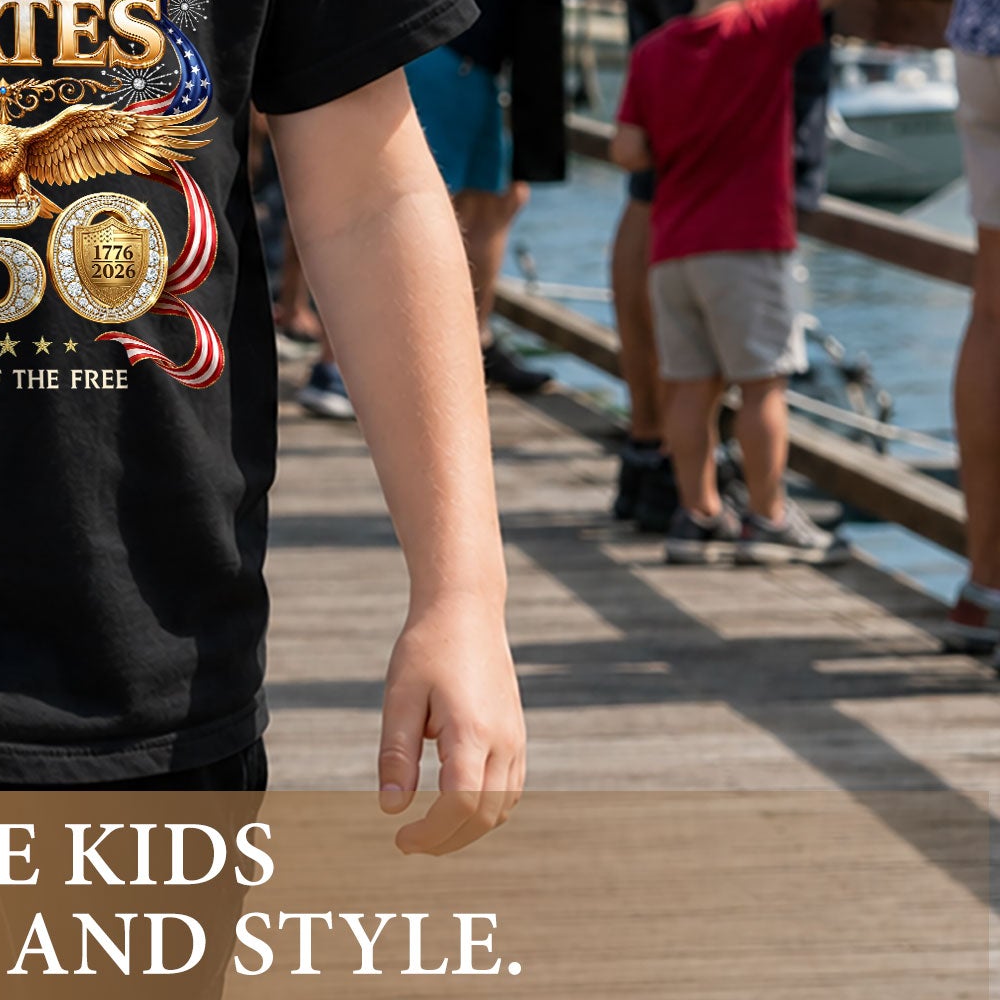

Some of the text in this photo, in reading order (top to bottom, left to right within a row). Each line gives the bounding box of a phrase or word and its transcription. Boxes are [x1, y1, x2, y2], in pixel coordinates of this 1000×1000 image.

[93, 244, 134, 260] 1776
[91, 263, 136, 279] 2026
[12, 369, 59, 390] THE
[70, 369, 129, 390] FREE
